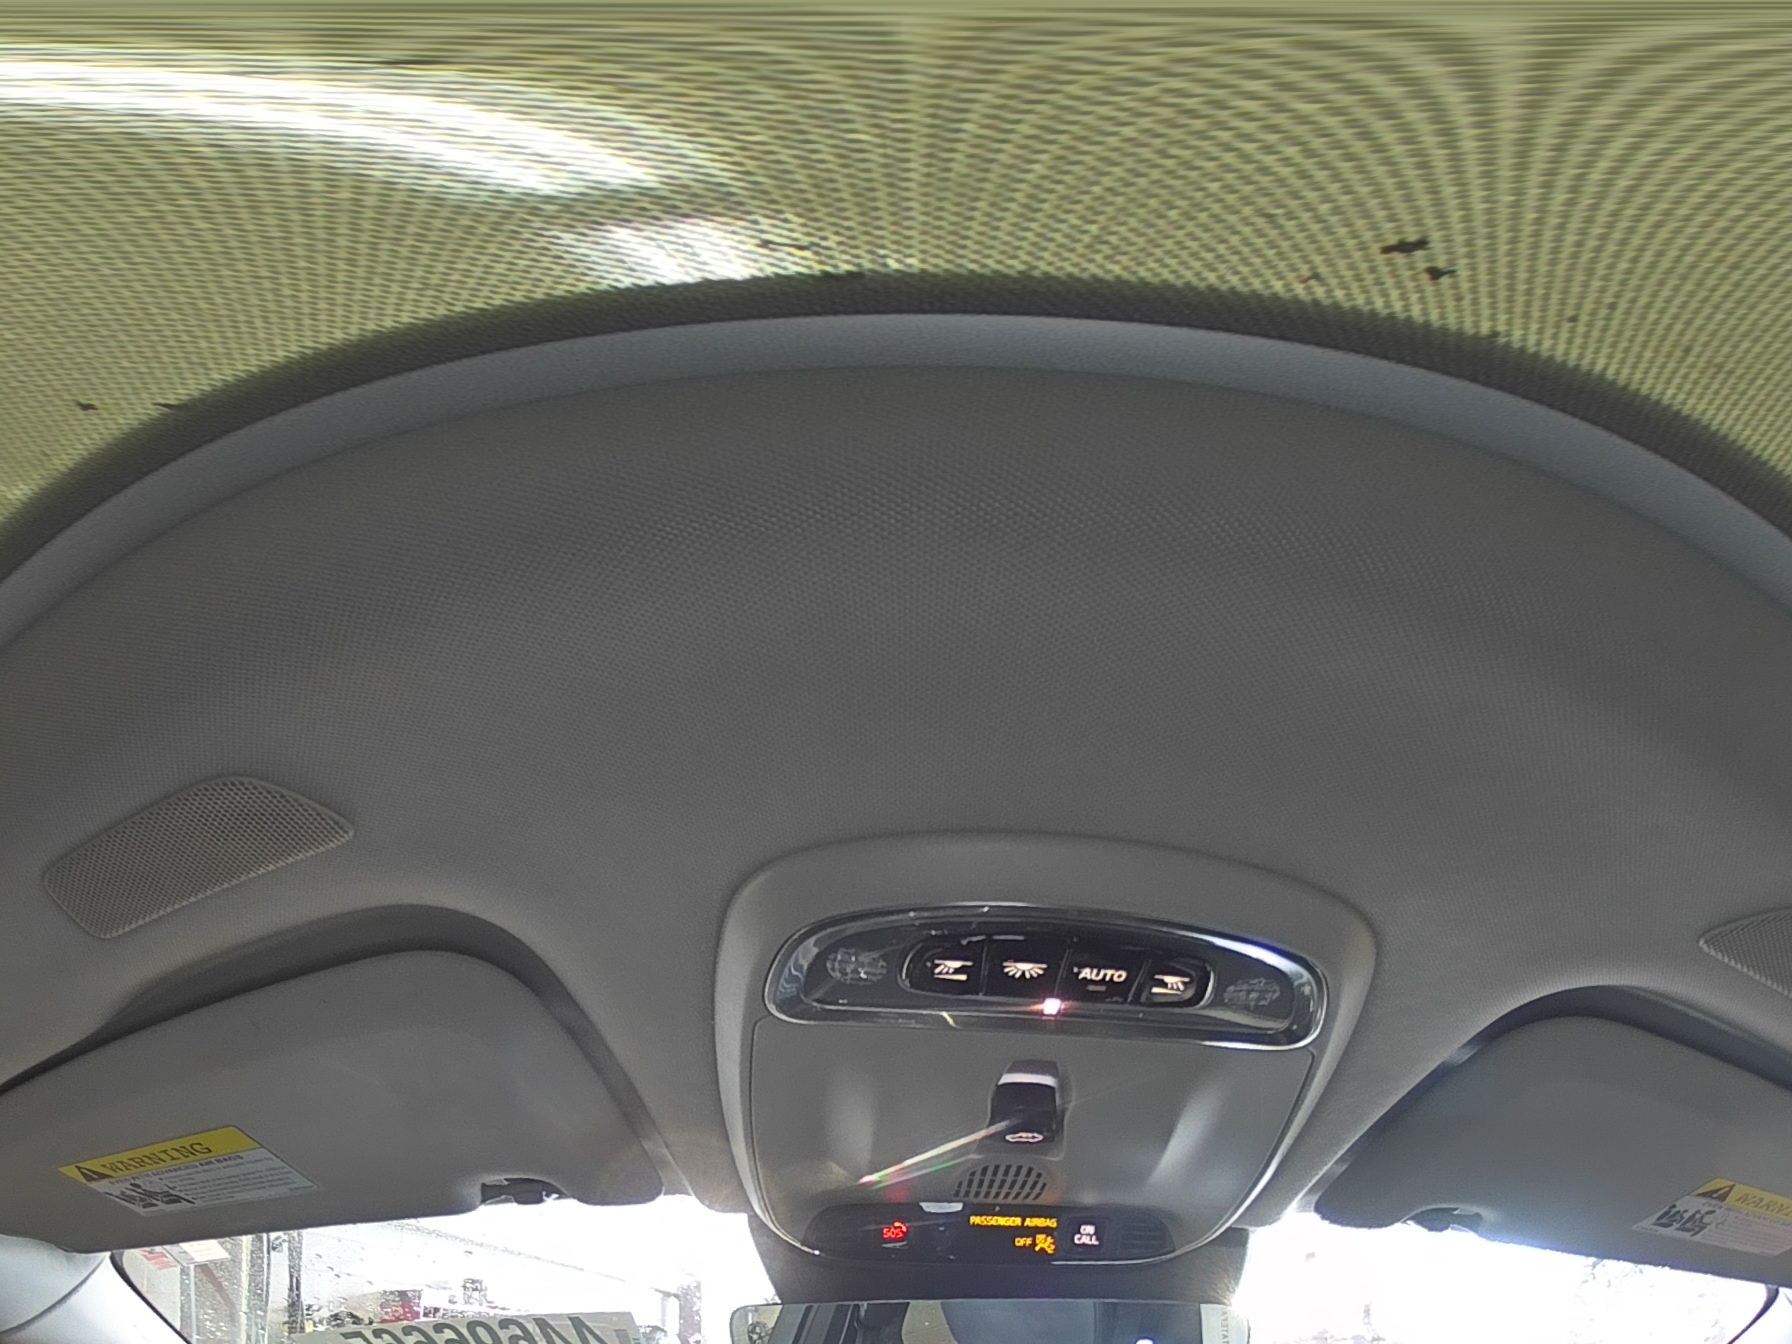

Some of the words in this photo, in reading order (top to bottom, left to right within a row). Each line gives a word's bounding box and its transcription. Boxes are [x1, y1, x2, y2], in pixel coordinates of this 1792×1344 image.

[1078, 966, 1127, 982] AUTO
[100, 1142, 213, 1174] WARNING
[198, 1159, 216, 1168] AIR
[216, 1154, 244, 1164] BAGS
[970, 1215, 1022, 1226] PASSENGER
[1024, 1217, 1057, 1228] AIRBAG
[883, 1226, 903, 1239] SOS
[1080, 1225, 1096, 1234] ON
[1014, 1237, 1033, 1247] OFF
[1074, 1233, 1099, 1245] CALL
